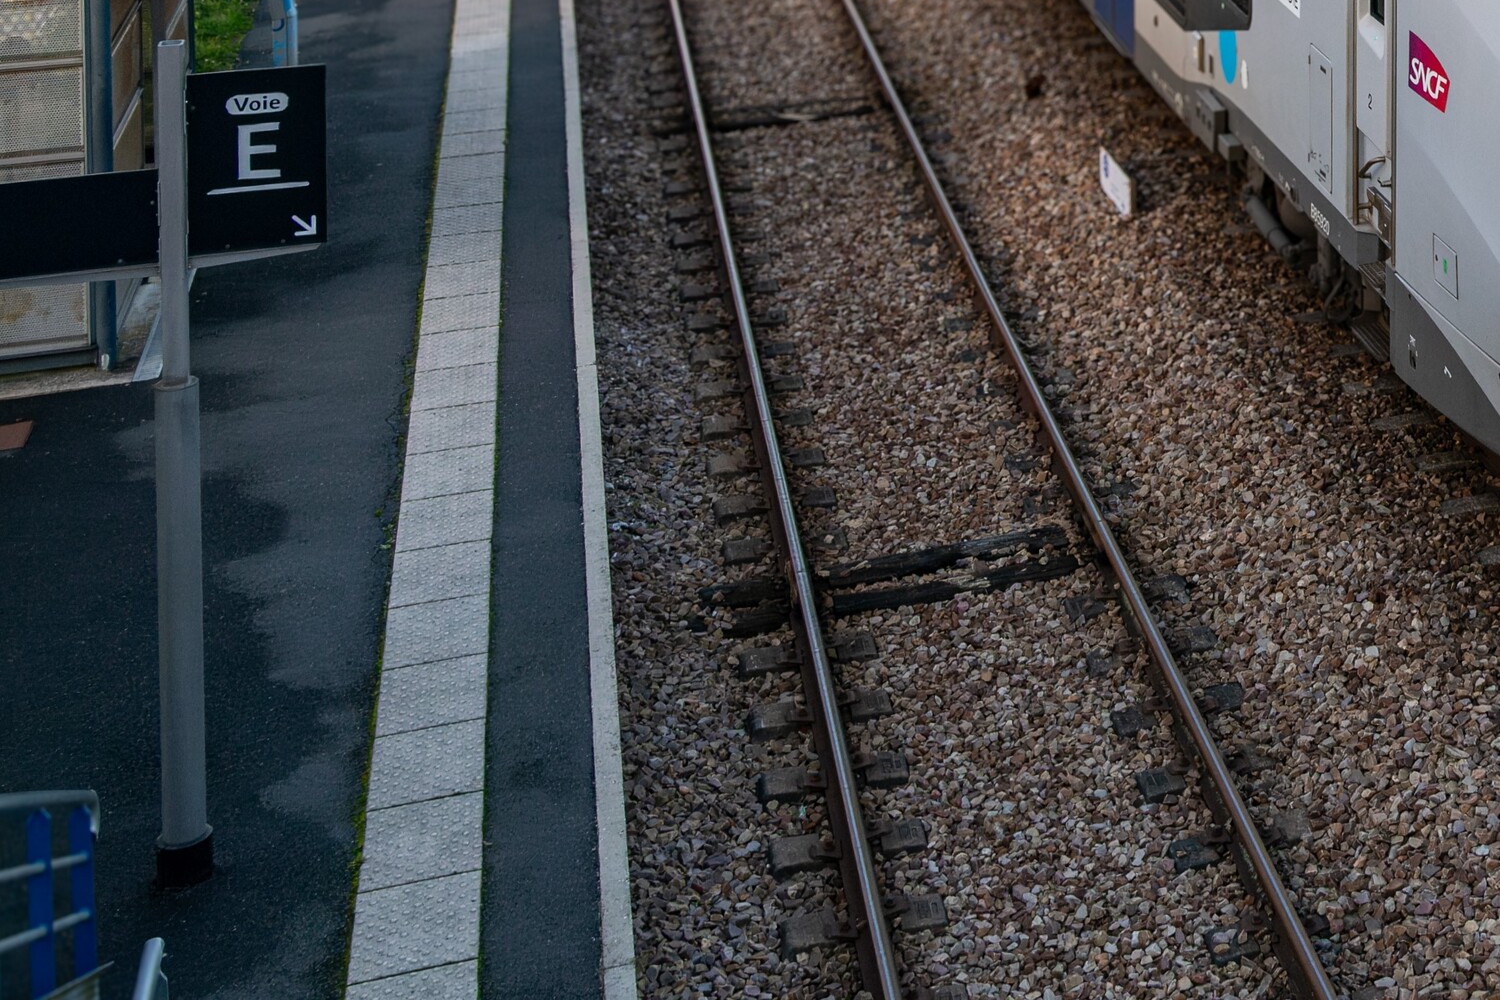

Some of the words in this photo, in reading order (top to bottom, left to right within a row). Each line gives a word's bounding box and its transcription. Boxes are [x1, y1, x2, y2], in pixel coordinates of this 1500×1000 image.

[1409, 57, 1448, 100] SNCF
[233, 96, 281, 112] Voie
[1367, 92, 1373, 110] 2
[237, 121, 282, 180] E
